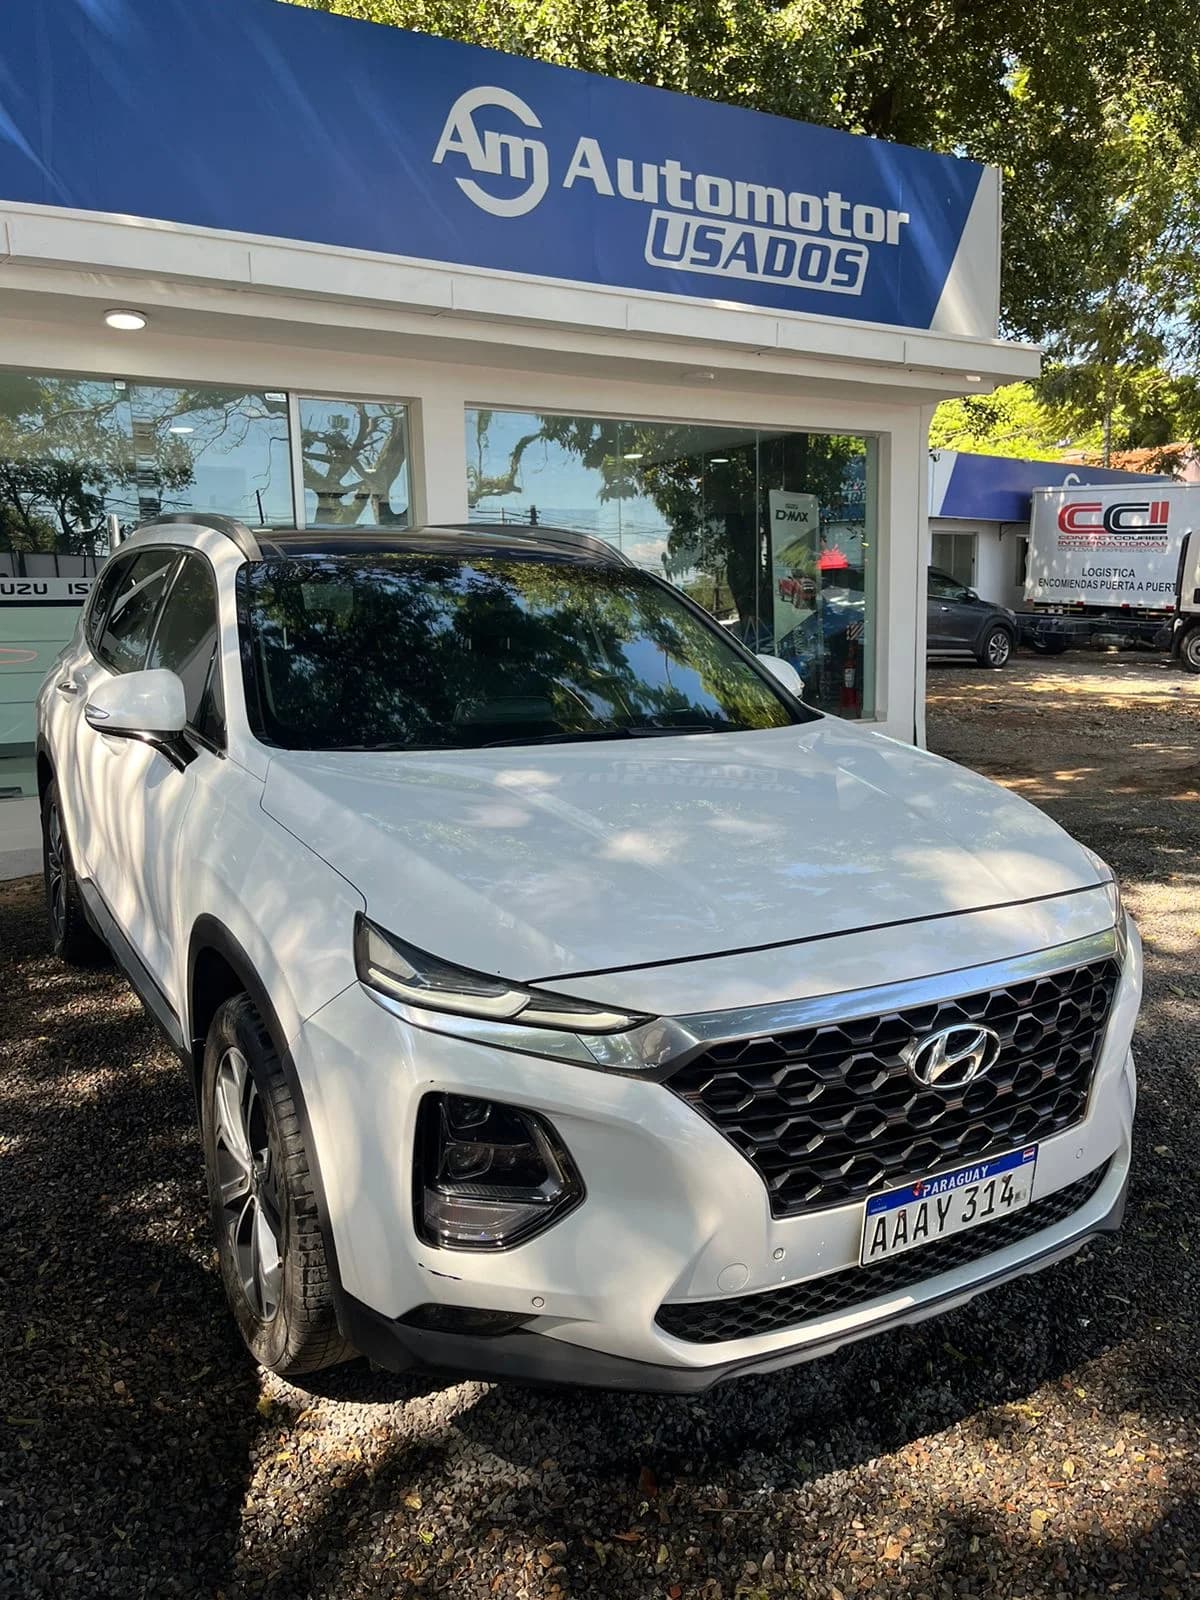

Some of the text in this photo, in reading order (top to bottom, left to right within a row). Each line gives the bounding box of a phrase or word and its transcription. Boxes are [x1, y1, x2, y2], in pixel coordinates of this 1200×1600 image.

[562, 136, 910, 245] Automotor
[651, 217, 863, 288] USADOS
[1038, 577, 1098, 589] ENCOMIENDAS
[1100, 579, 1134, 591] PUERTA
[1137, 581, 1144, 591] A
[1082, 567, 1135, 578] LOGISTICA
[923, 1165, 989, 1197] PARAGUAY
[870, 1174, 1014, 1256] AAAY 314
